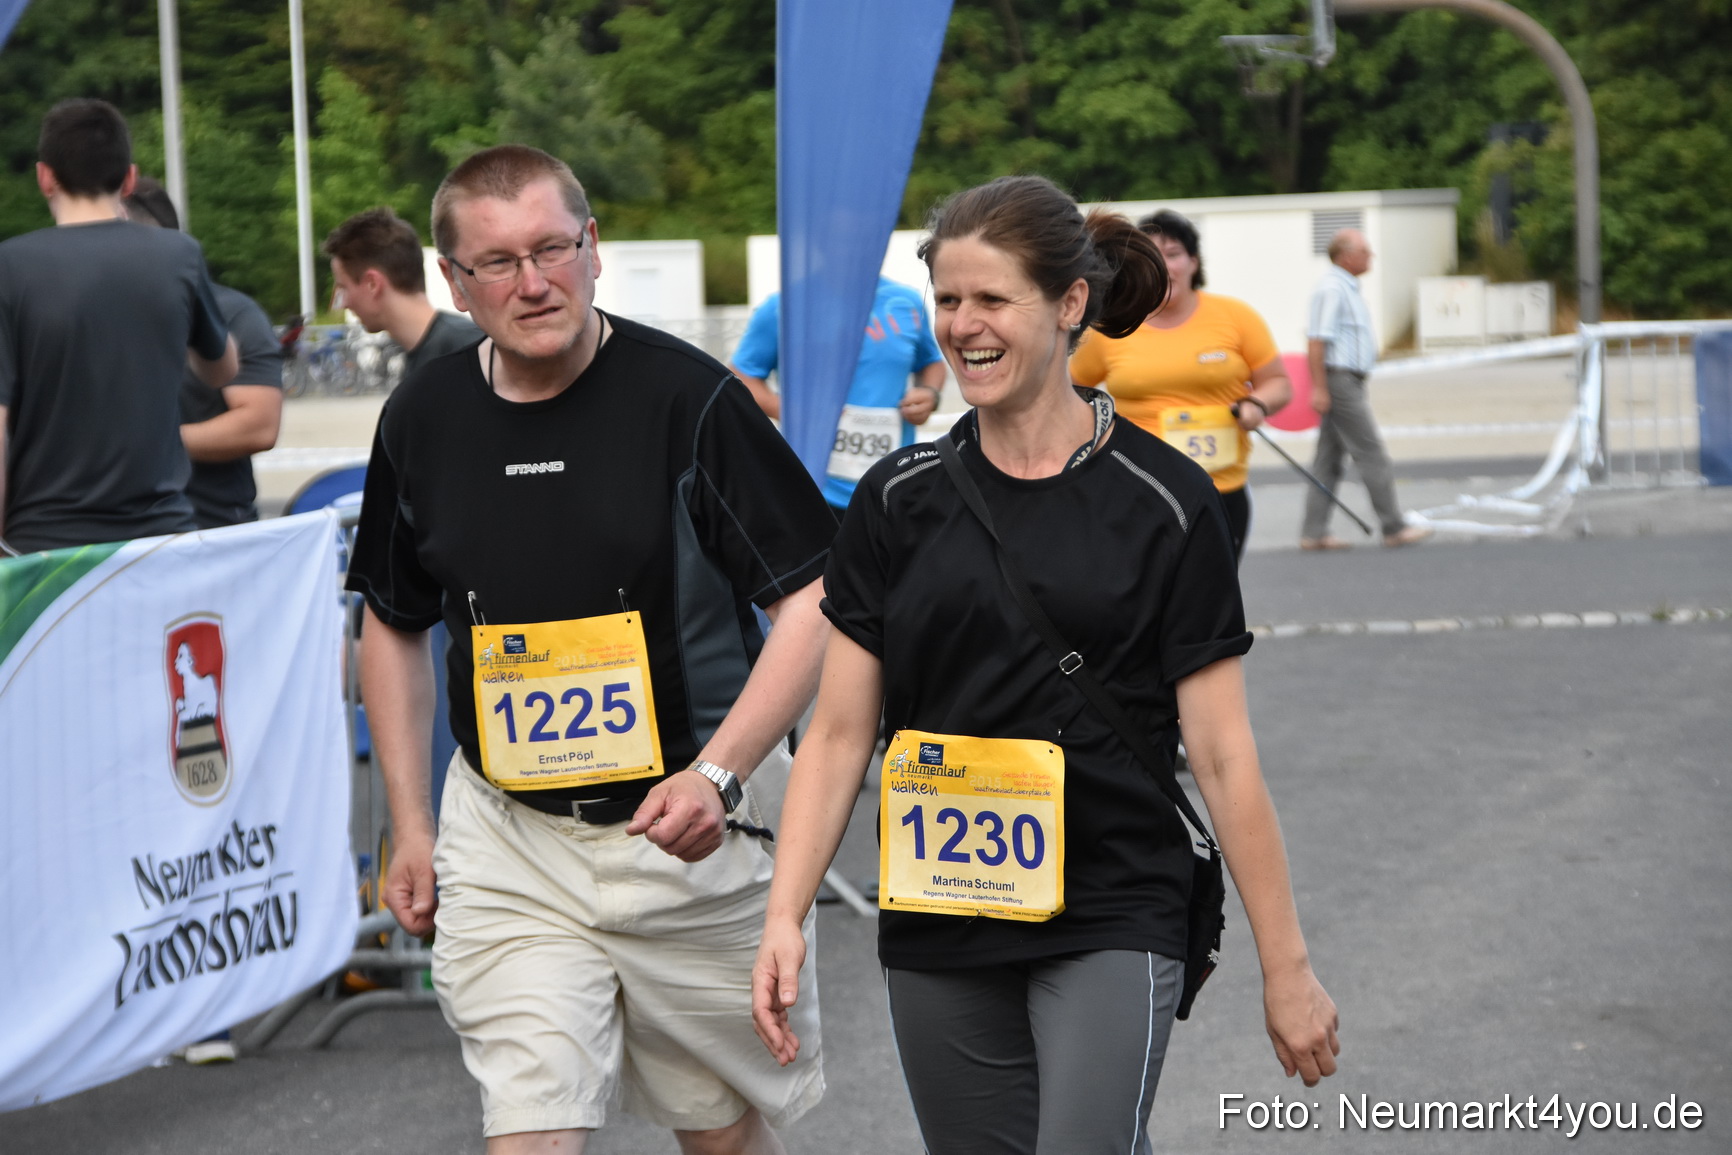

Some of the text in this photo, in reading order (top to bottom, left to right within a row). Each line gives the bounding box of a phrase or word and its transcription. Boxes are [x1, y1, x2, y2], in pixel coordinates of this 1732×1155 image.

[833, 429, 893, 458] 8939
[1187, 434, 1217, 458] 53
[505, 460, 564, 476] STANNO
[495, 649, 550, 664] firmenlauf
[553, 653, 587, 668] 2015
[481, 670, 525, 684] walken
[494, 682, 637, 743] 1225
[538, 750, 594, 764] Ernst Pöpl
[186, 759, 218, 789] 1628
[561, 764, 594, 773] Lauterhofen
[907, 761, 966, 778] firmenlauf
[891, 779, 939, 796] walken
[969, 775, 1001, 788] 2015
[902, 804, 1045, 870] 1230
[932, 875, 1015, 892] Martina Schuml
[923, 889, 1023, 905] Regens Wagner Lauterhofen Stiftung
